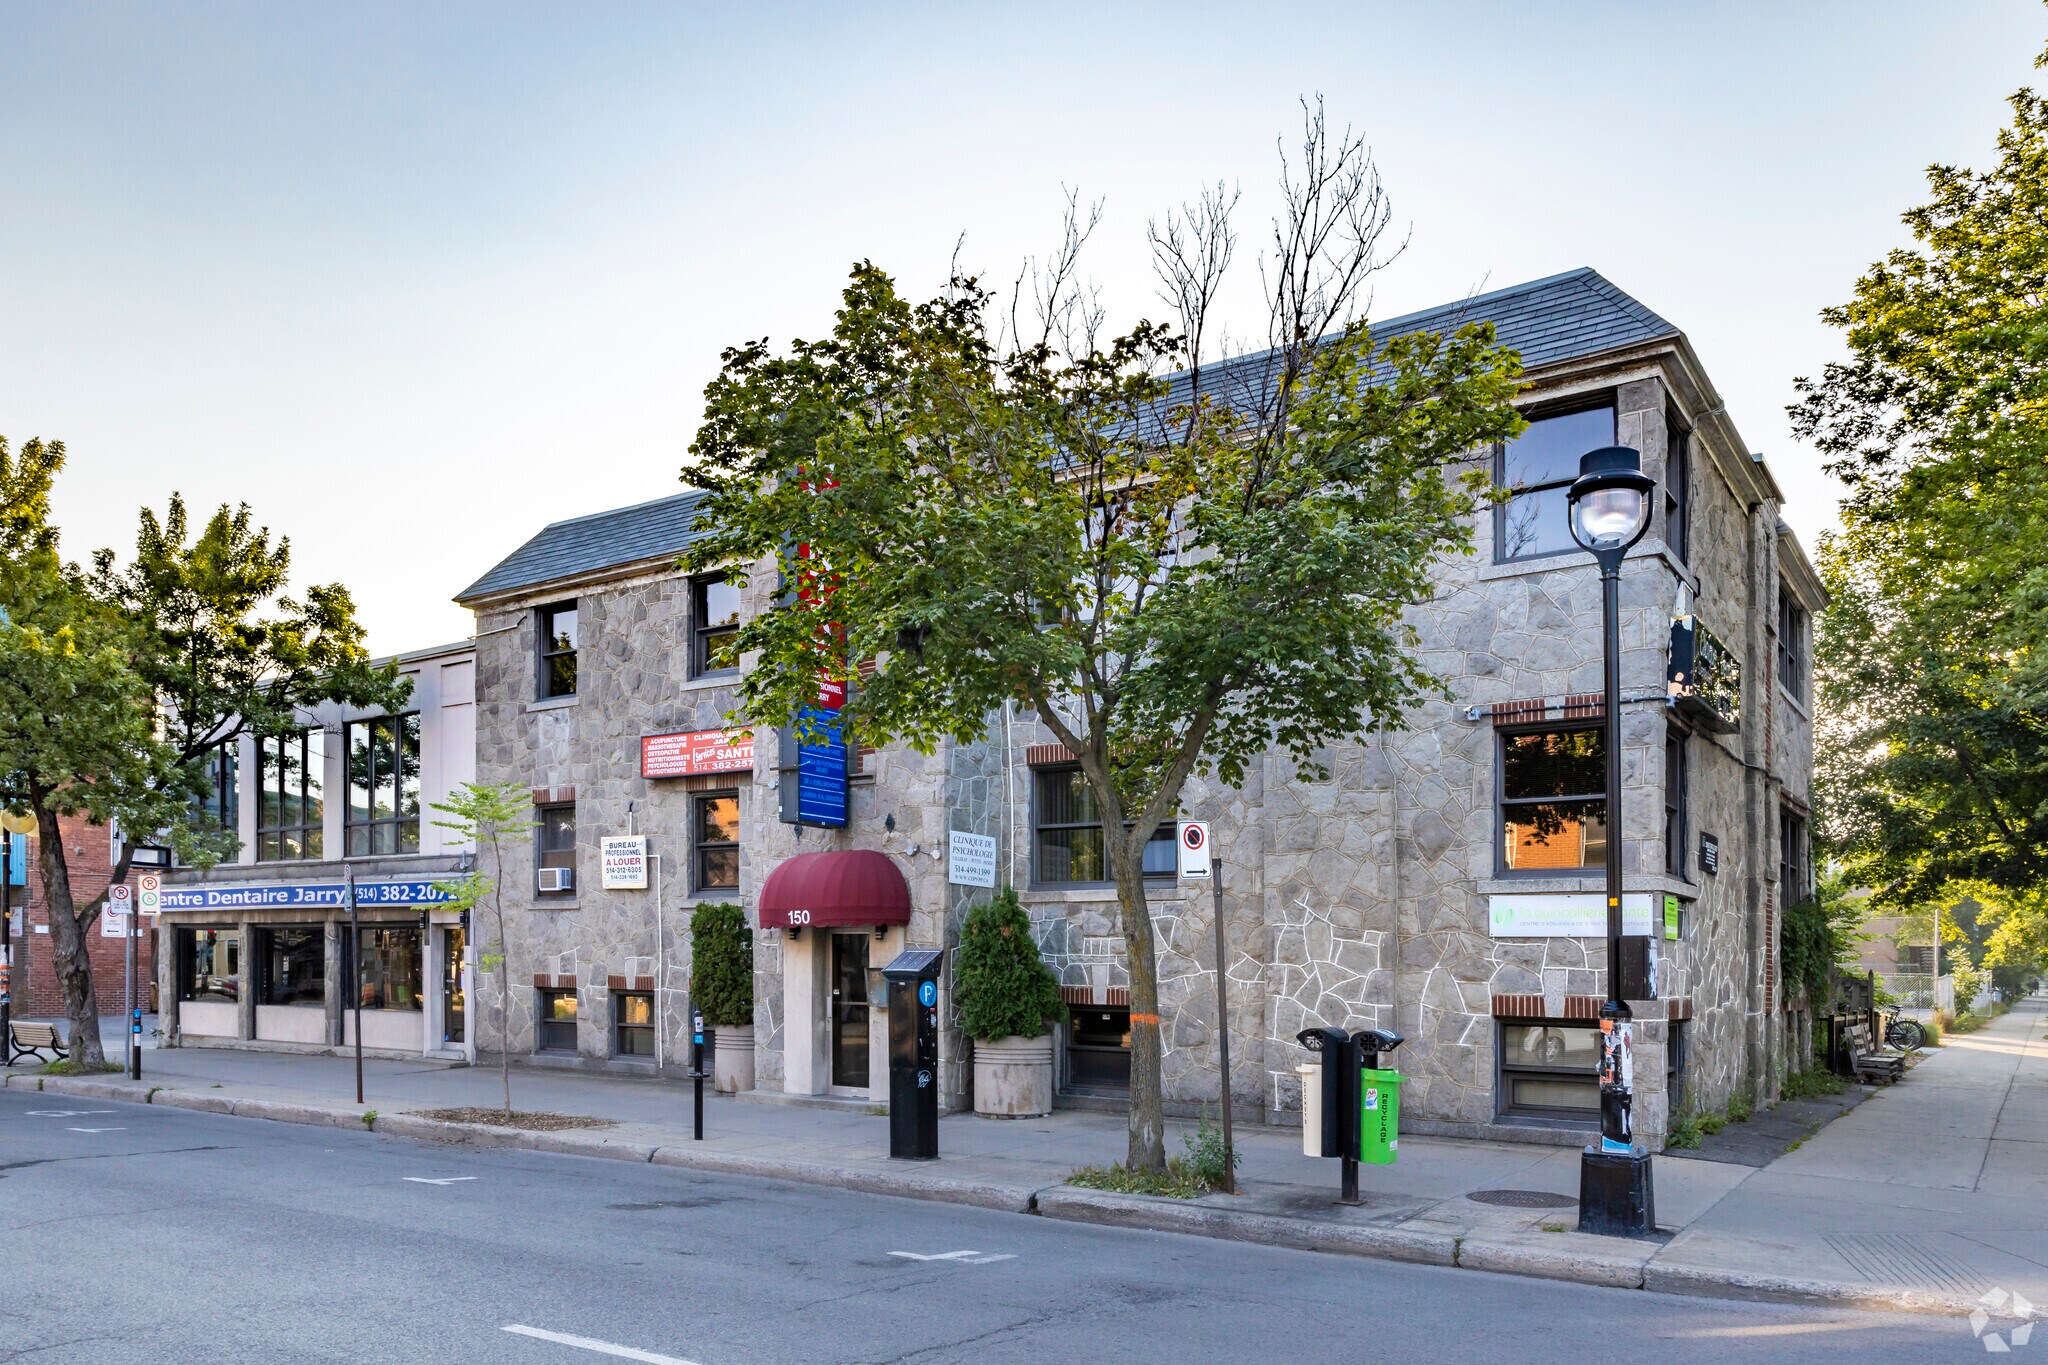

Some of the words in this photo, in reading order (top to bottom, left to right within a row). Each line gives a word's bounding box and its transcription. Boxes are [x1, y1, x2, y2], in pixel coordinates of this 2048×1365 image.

[650, 735, 687, 745] ACUPUNCTURE
[647, 742, 687, 751] MASSOTHERAPIE
[647, 749, 680, 757] OSTEOPATHE
[695, 748, 716, 762] Services
[647, 754, 691, 764] NUTRITIONNISTE
[712, 759, 754, 770] 382-257
[609, 841, 637, 849] BUREAU
[953, 835, 983, 847] CLINIQUE
[984, 840, 993, 848] DE
[952, 846, 994, 859] PSYCHOLOGIE
[613, 857, 641, 866] LOUER
[606, 866, 642, 874] 514-312-6305
[161, 893, 203, 906] entre
[208, 889, 288, 905] Dentaire
[294, 887, 345, 905] Jarry
[354, 886, 378, 902] (514)
[787, 909, 810, 925] 150
[1380, 1093, 1389, 1143] RECYCLAGE
